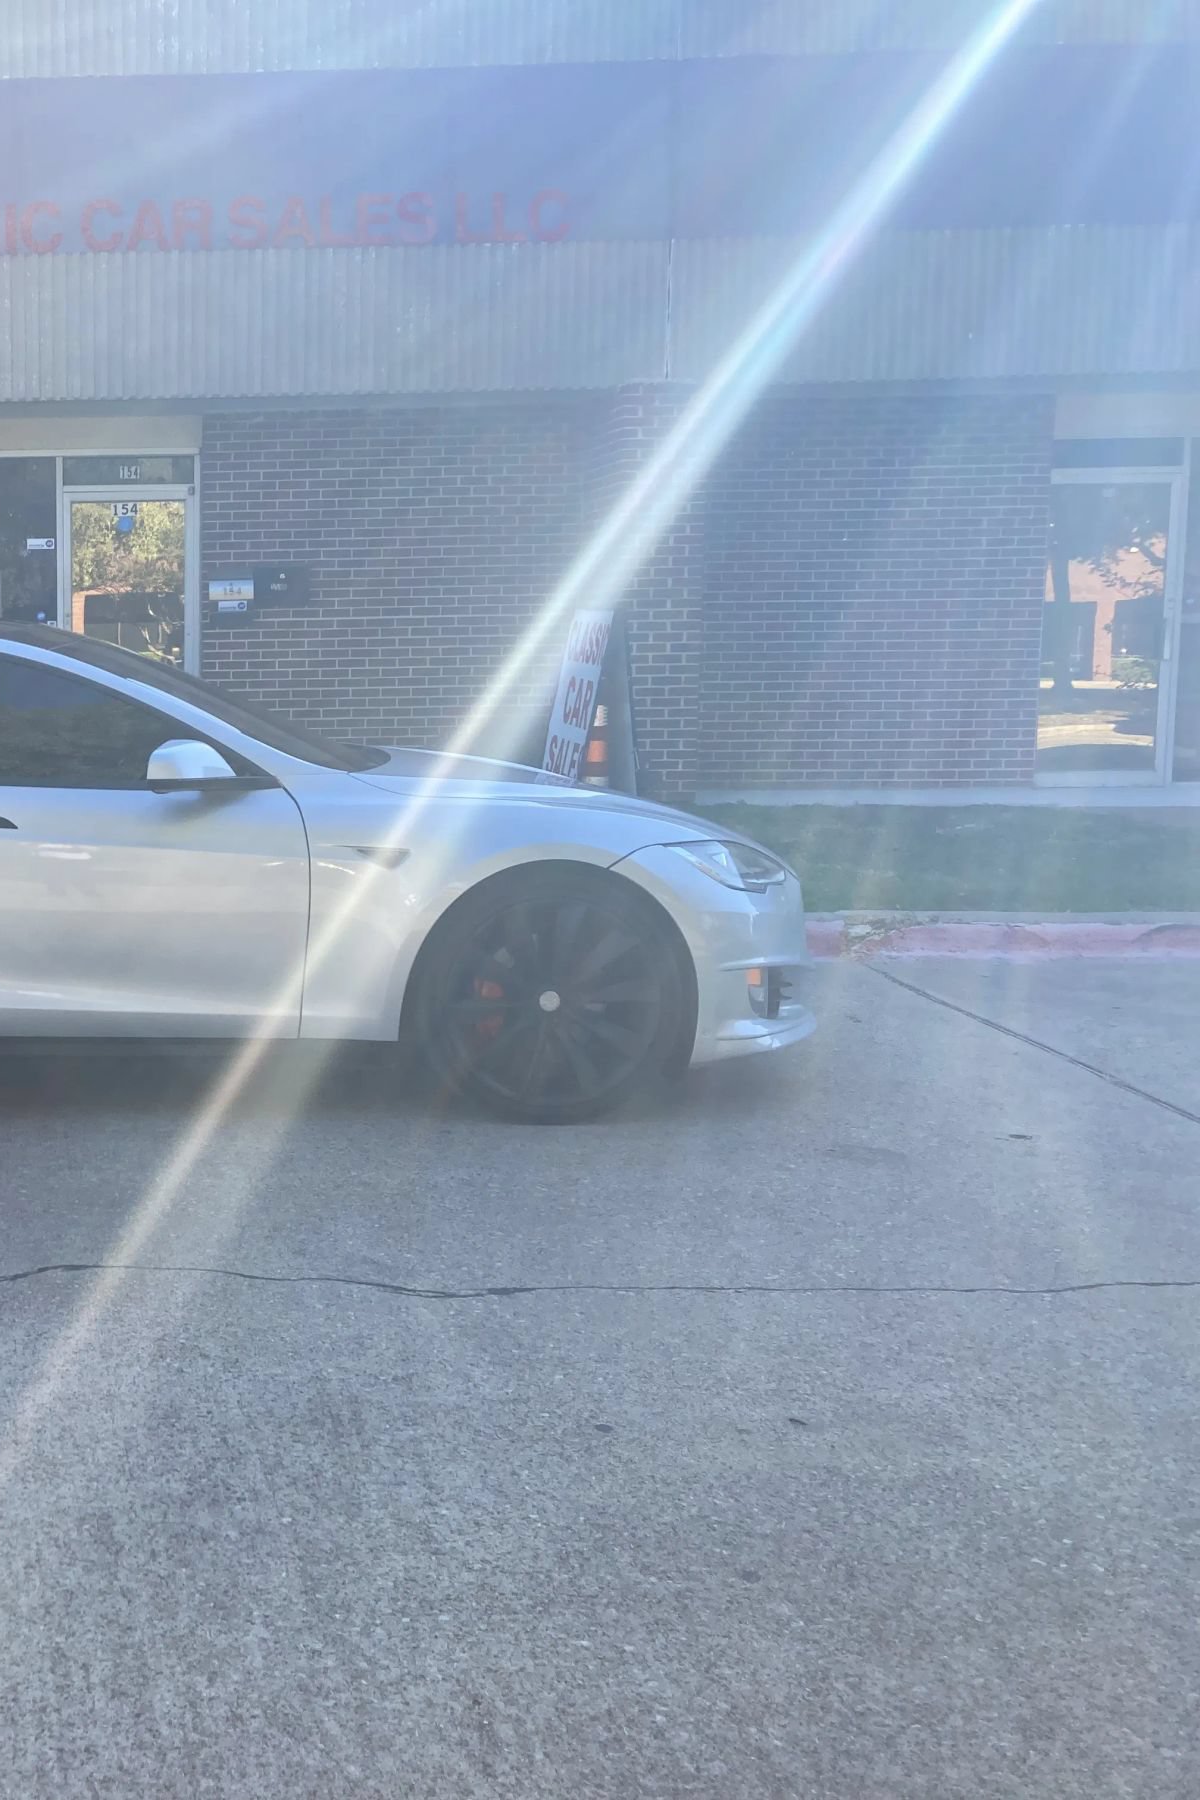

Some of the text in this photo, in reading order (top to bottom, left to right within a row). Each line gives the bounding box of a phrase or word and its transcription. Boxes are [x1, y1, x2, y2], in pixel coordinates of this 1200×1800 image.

[81, 198, 213, 252] CAR
[227, 191, 438, 249] SALES
[455, 188, 571, 243] LLC
[120, 465, 140, 479] 154
[113, 503, 138, 516] 154
[563, 676, 594, 730] CAR
